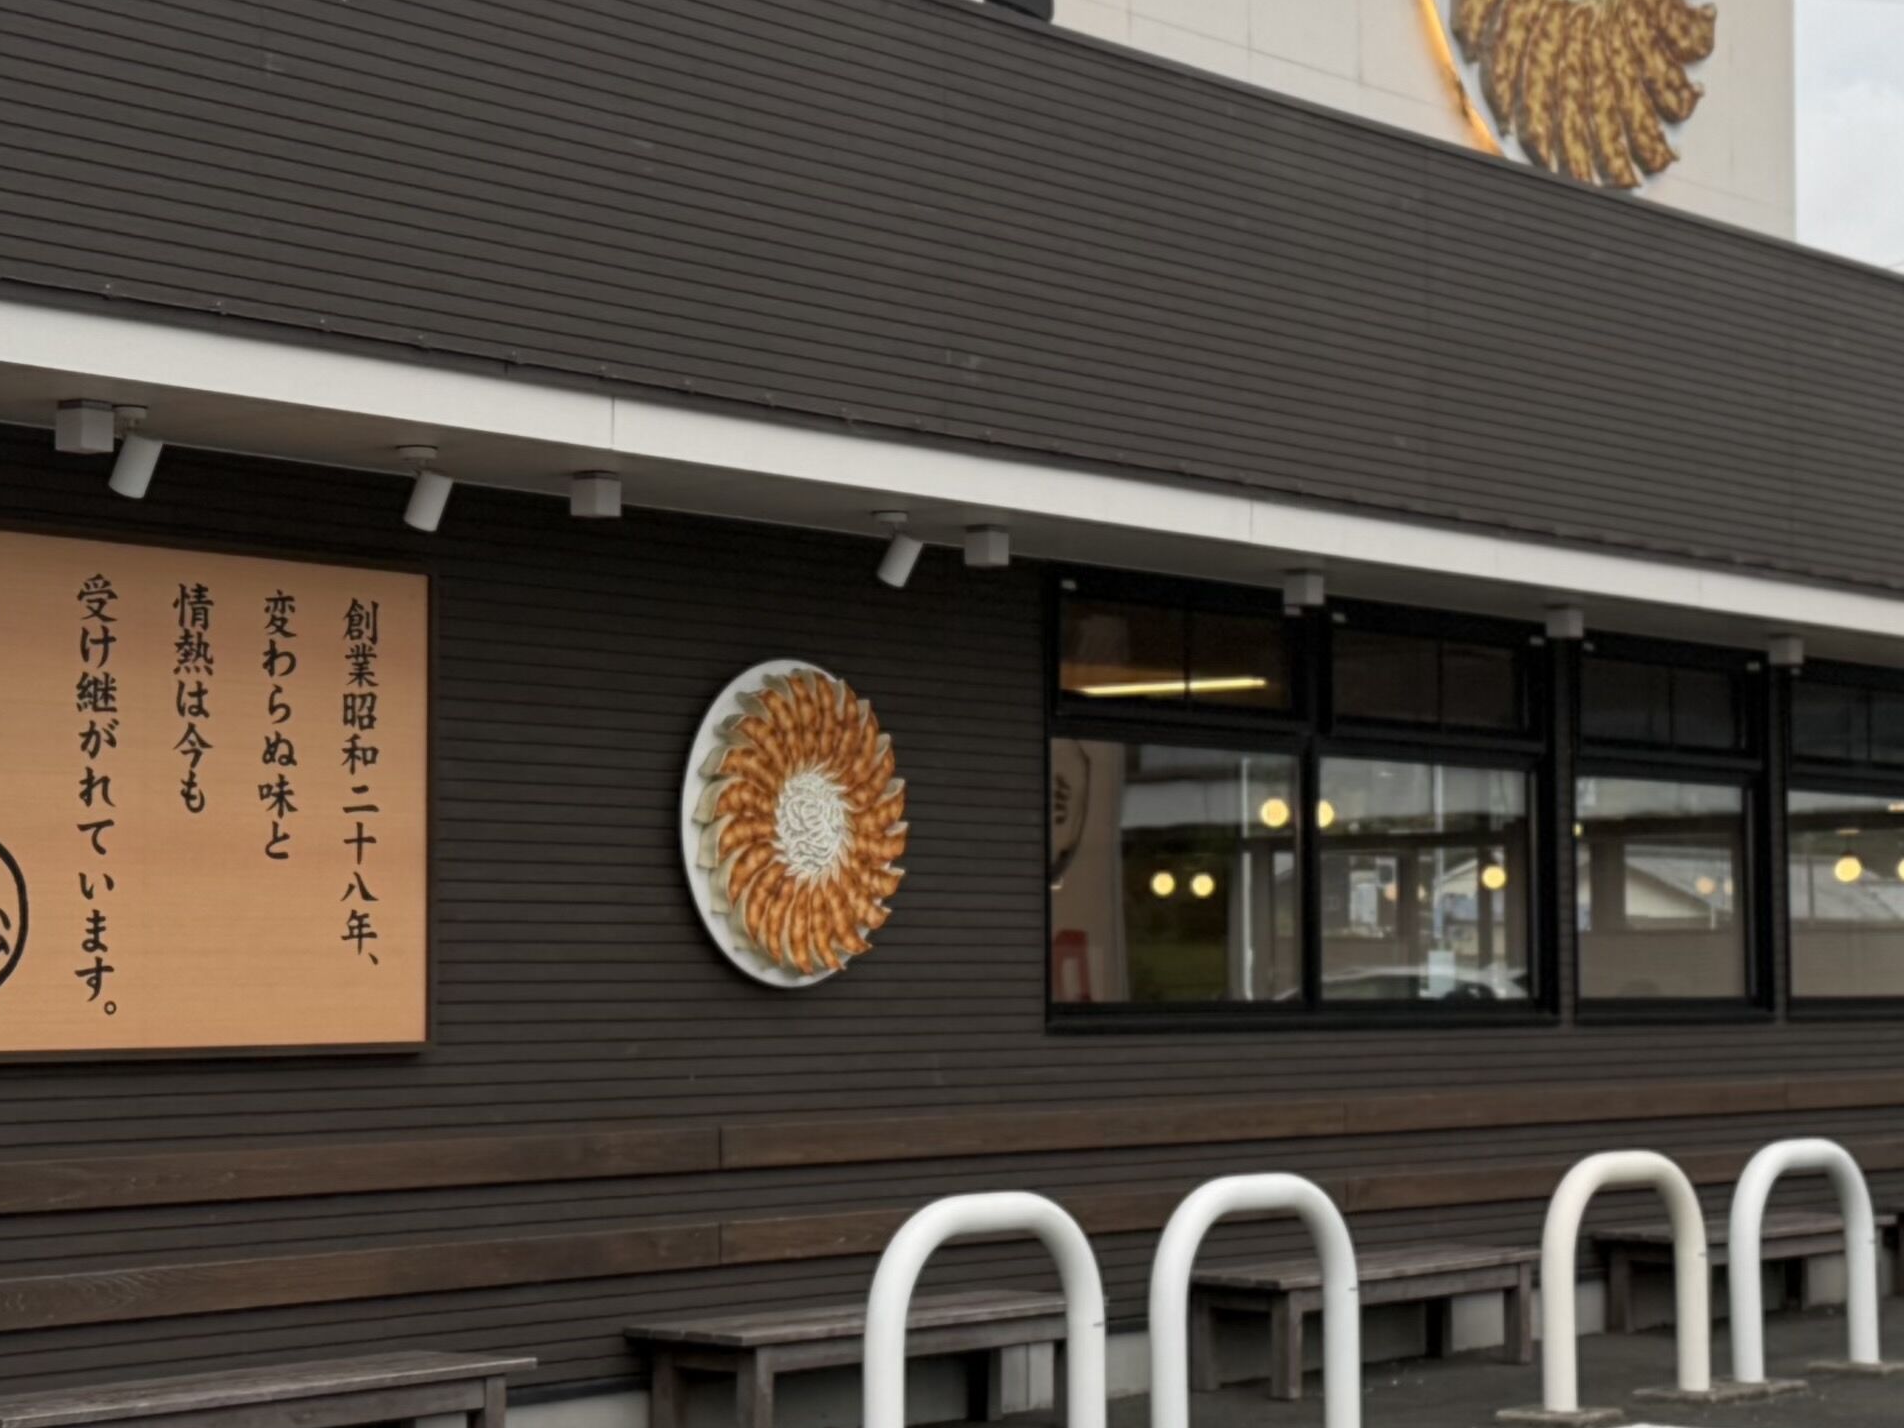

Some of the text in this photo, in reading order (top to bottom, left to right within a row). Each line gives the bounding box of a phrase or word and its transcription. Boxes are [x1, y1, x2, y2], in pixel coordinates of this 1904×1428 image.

[75, 573, 119, 1017] 受け継がれています。
[172, 582, 216, 815] 情熱は今も
[257, 588, 299, 862] 変わらぬ味と
[340, 596, 381, 966] 創業昭和二十八年、
